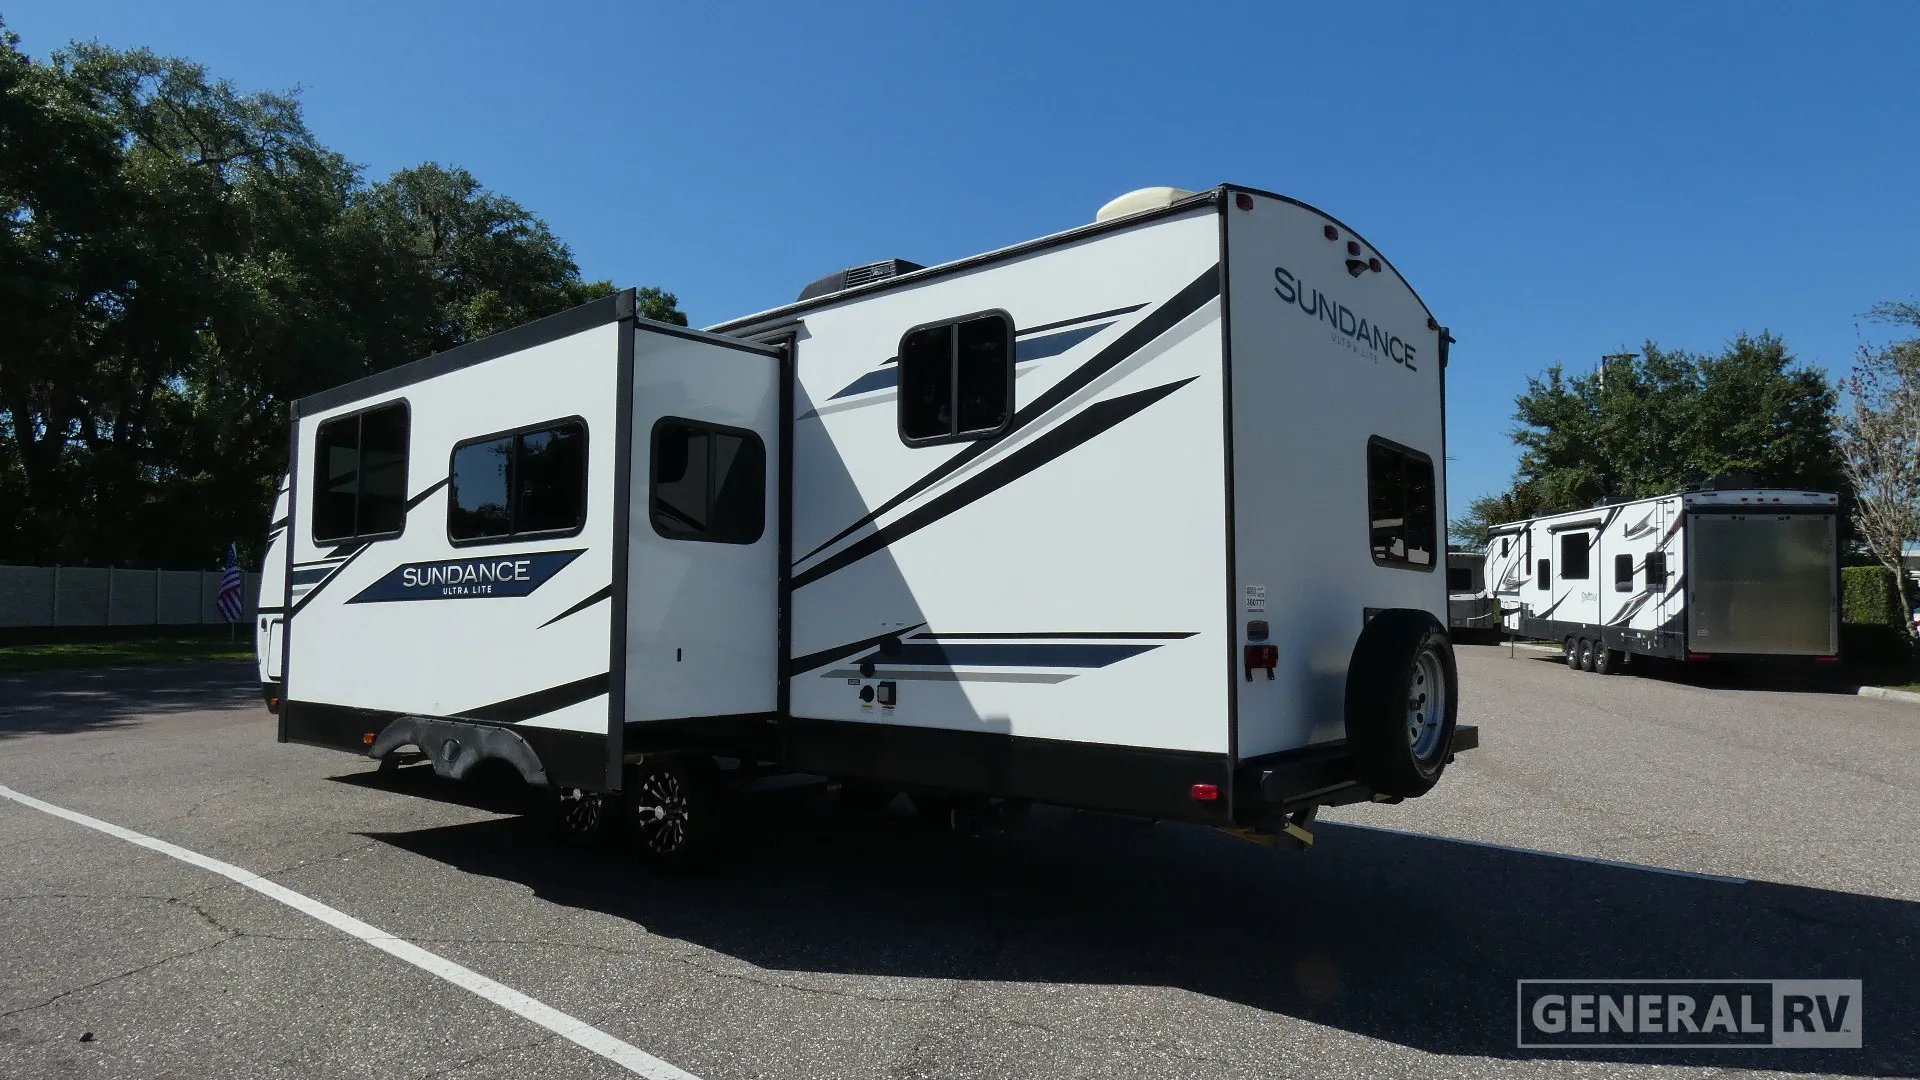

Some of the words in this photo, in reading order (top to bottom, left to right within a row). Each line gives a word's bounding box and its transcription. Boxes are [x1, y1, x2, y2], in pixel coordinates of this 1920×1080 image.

[1274, 266, 1417, 372] SUNDANCE
[403, 560, 530, 587] SUNDANCE
[443, 586, 469, 595] ULTRA
[472, 585, 492, 594] LITE
